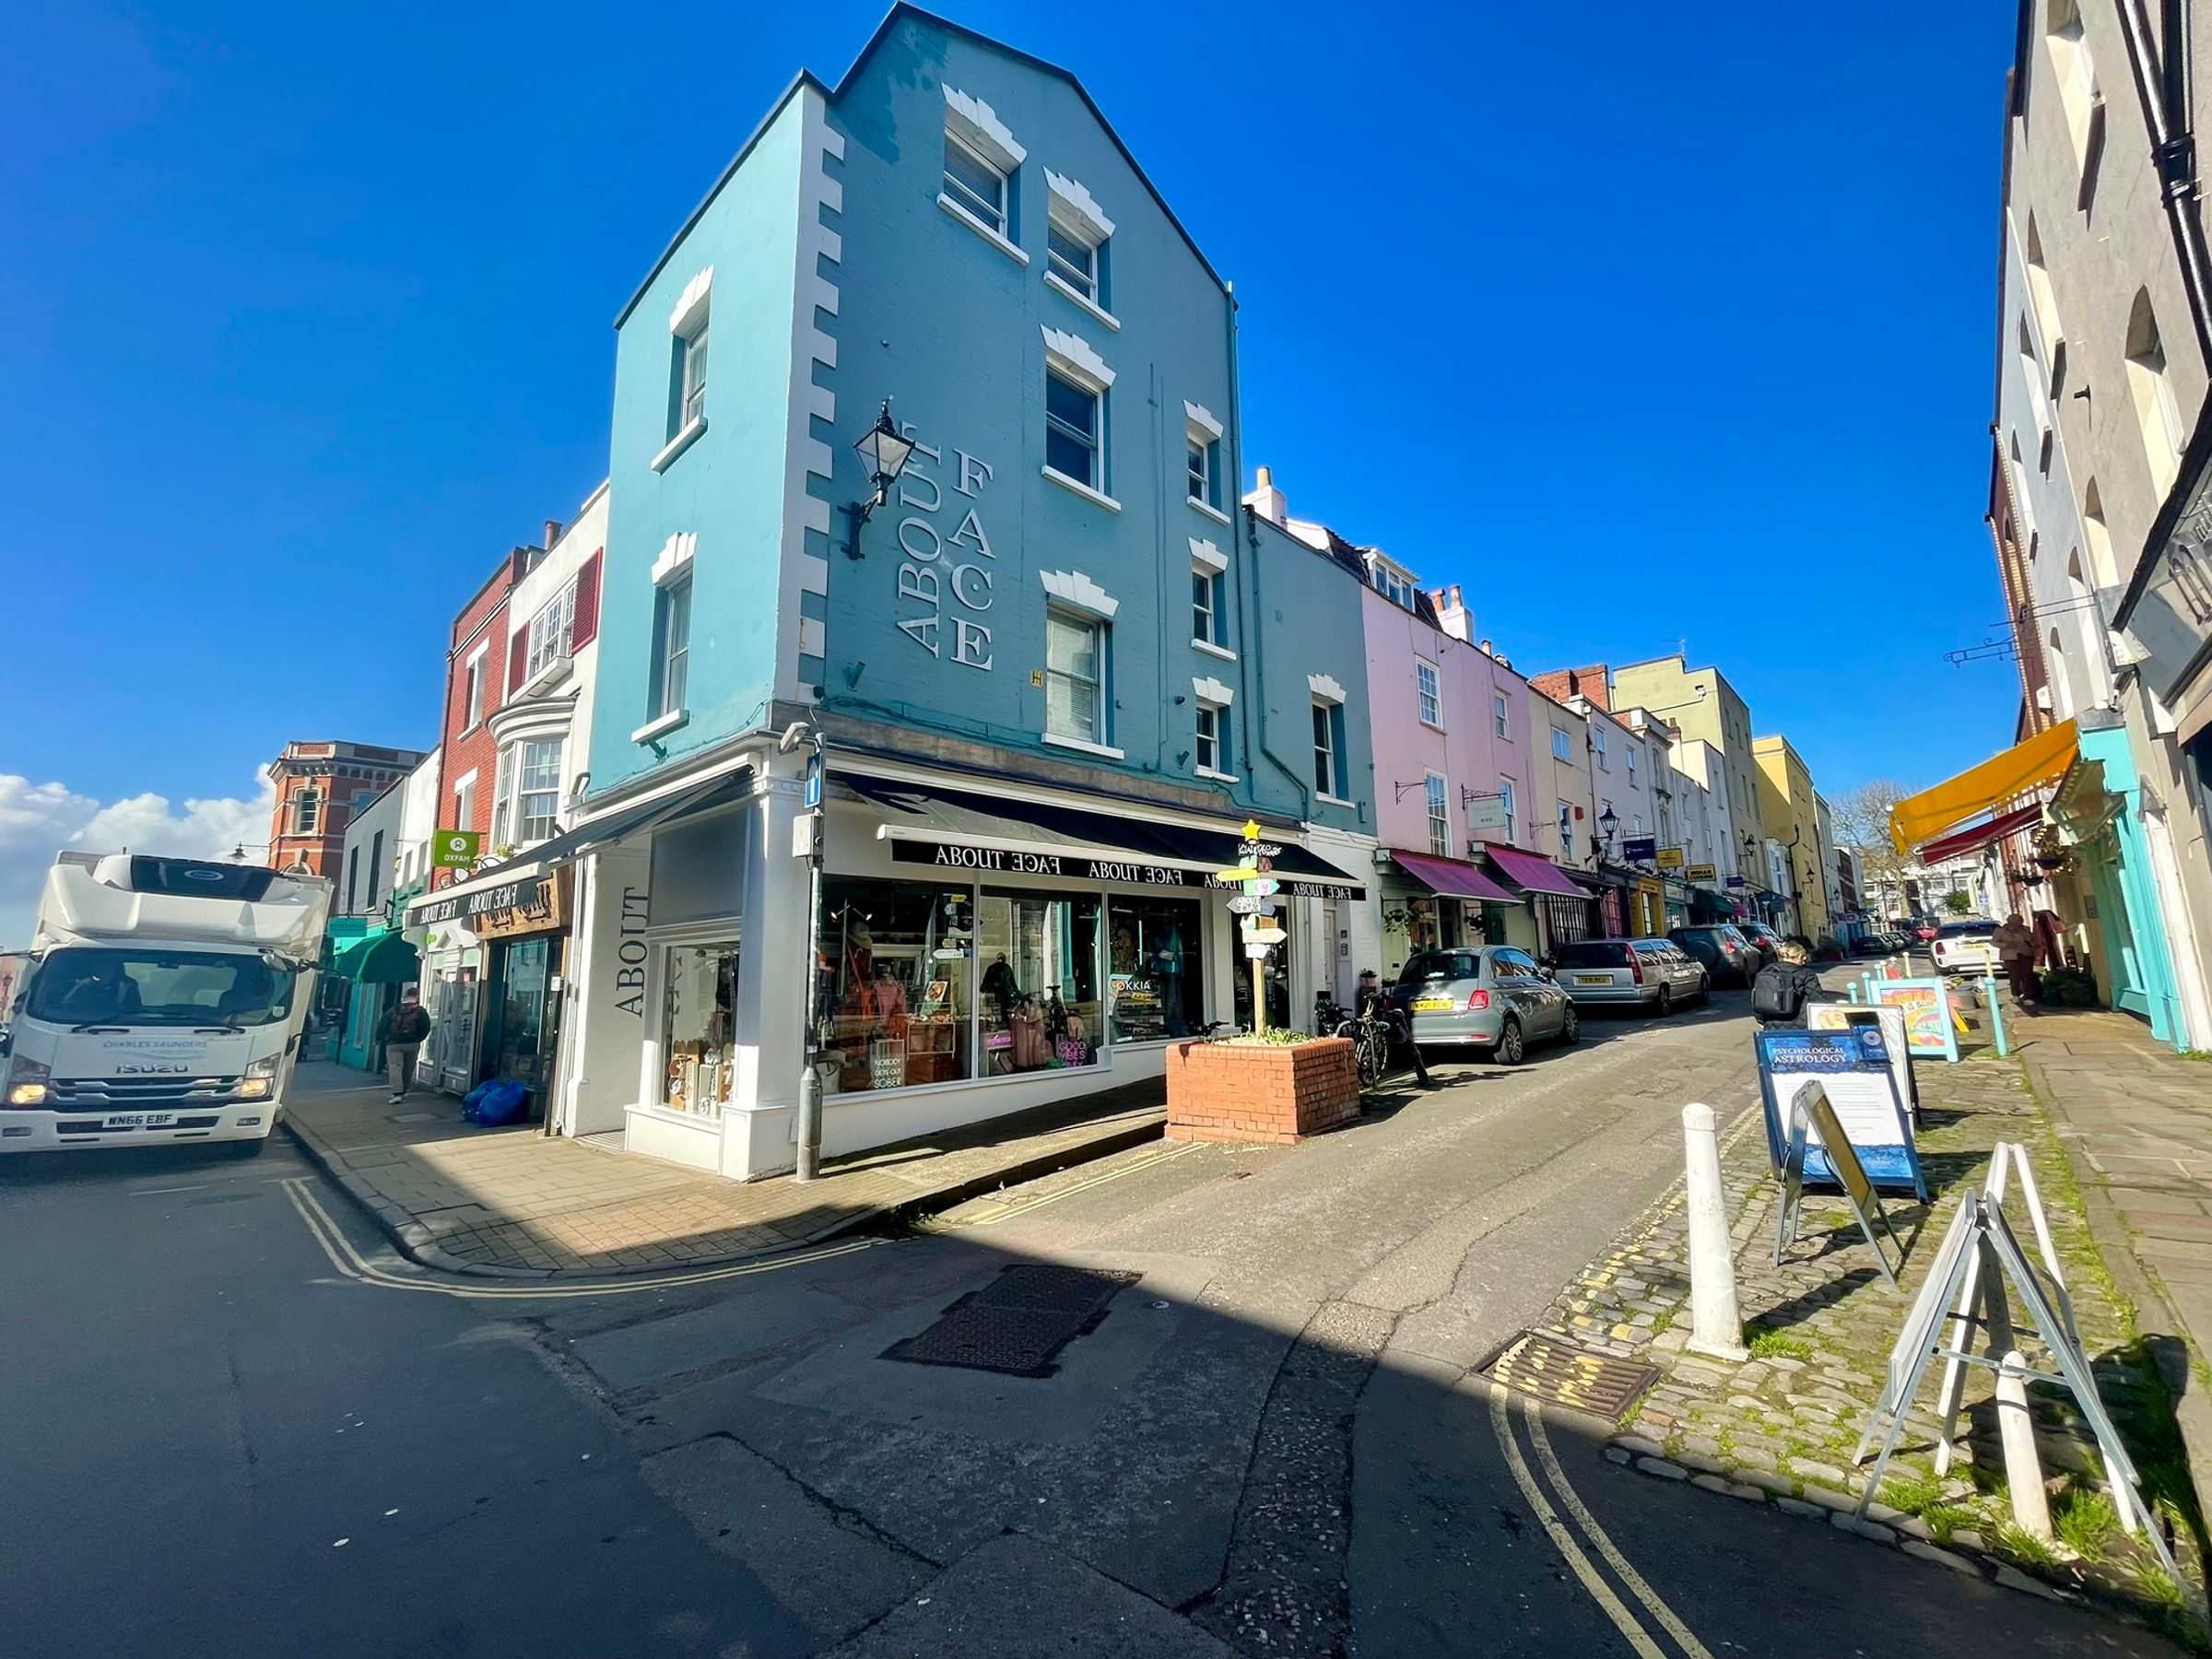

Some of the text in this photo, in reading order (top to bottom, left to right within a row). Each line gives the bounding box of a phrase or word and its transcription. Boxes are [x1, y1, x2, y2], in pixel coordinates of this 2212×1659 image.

[947, 448, 996, 671] FACE
[444, 854, 470, 863] OXFAM
[935, 845, 1004, 870] ABOUT
[1088, 861, 1140, 881] ABOUT
[1293, 883, 1324, 897] ABOUT
[615, 887, 648, 1018] ABOUT
[1116, 980, 1151, 991] OKKIA
[1059, 1041, 1086, 1051] GOOD
[1771, 1047, 1843, 1055] PSYCHOLOGICAL
[1773, 1053, 1847, 1064] ASTROLOGY
[116, 1064, 188, 1074] ISUZU
[874, 1077, 901, 1088] SOBER
[108, 1114, 173, 1125] WN66 EBF
